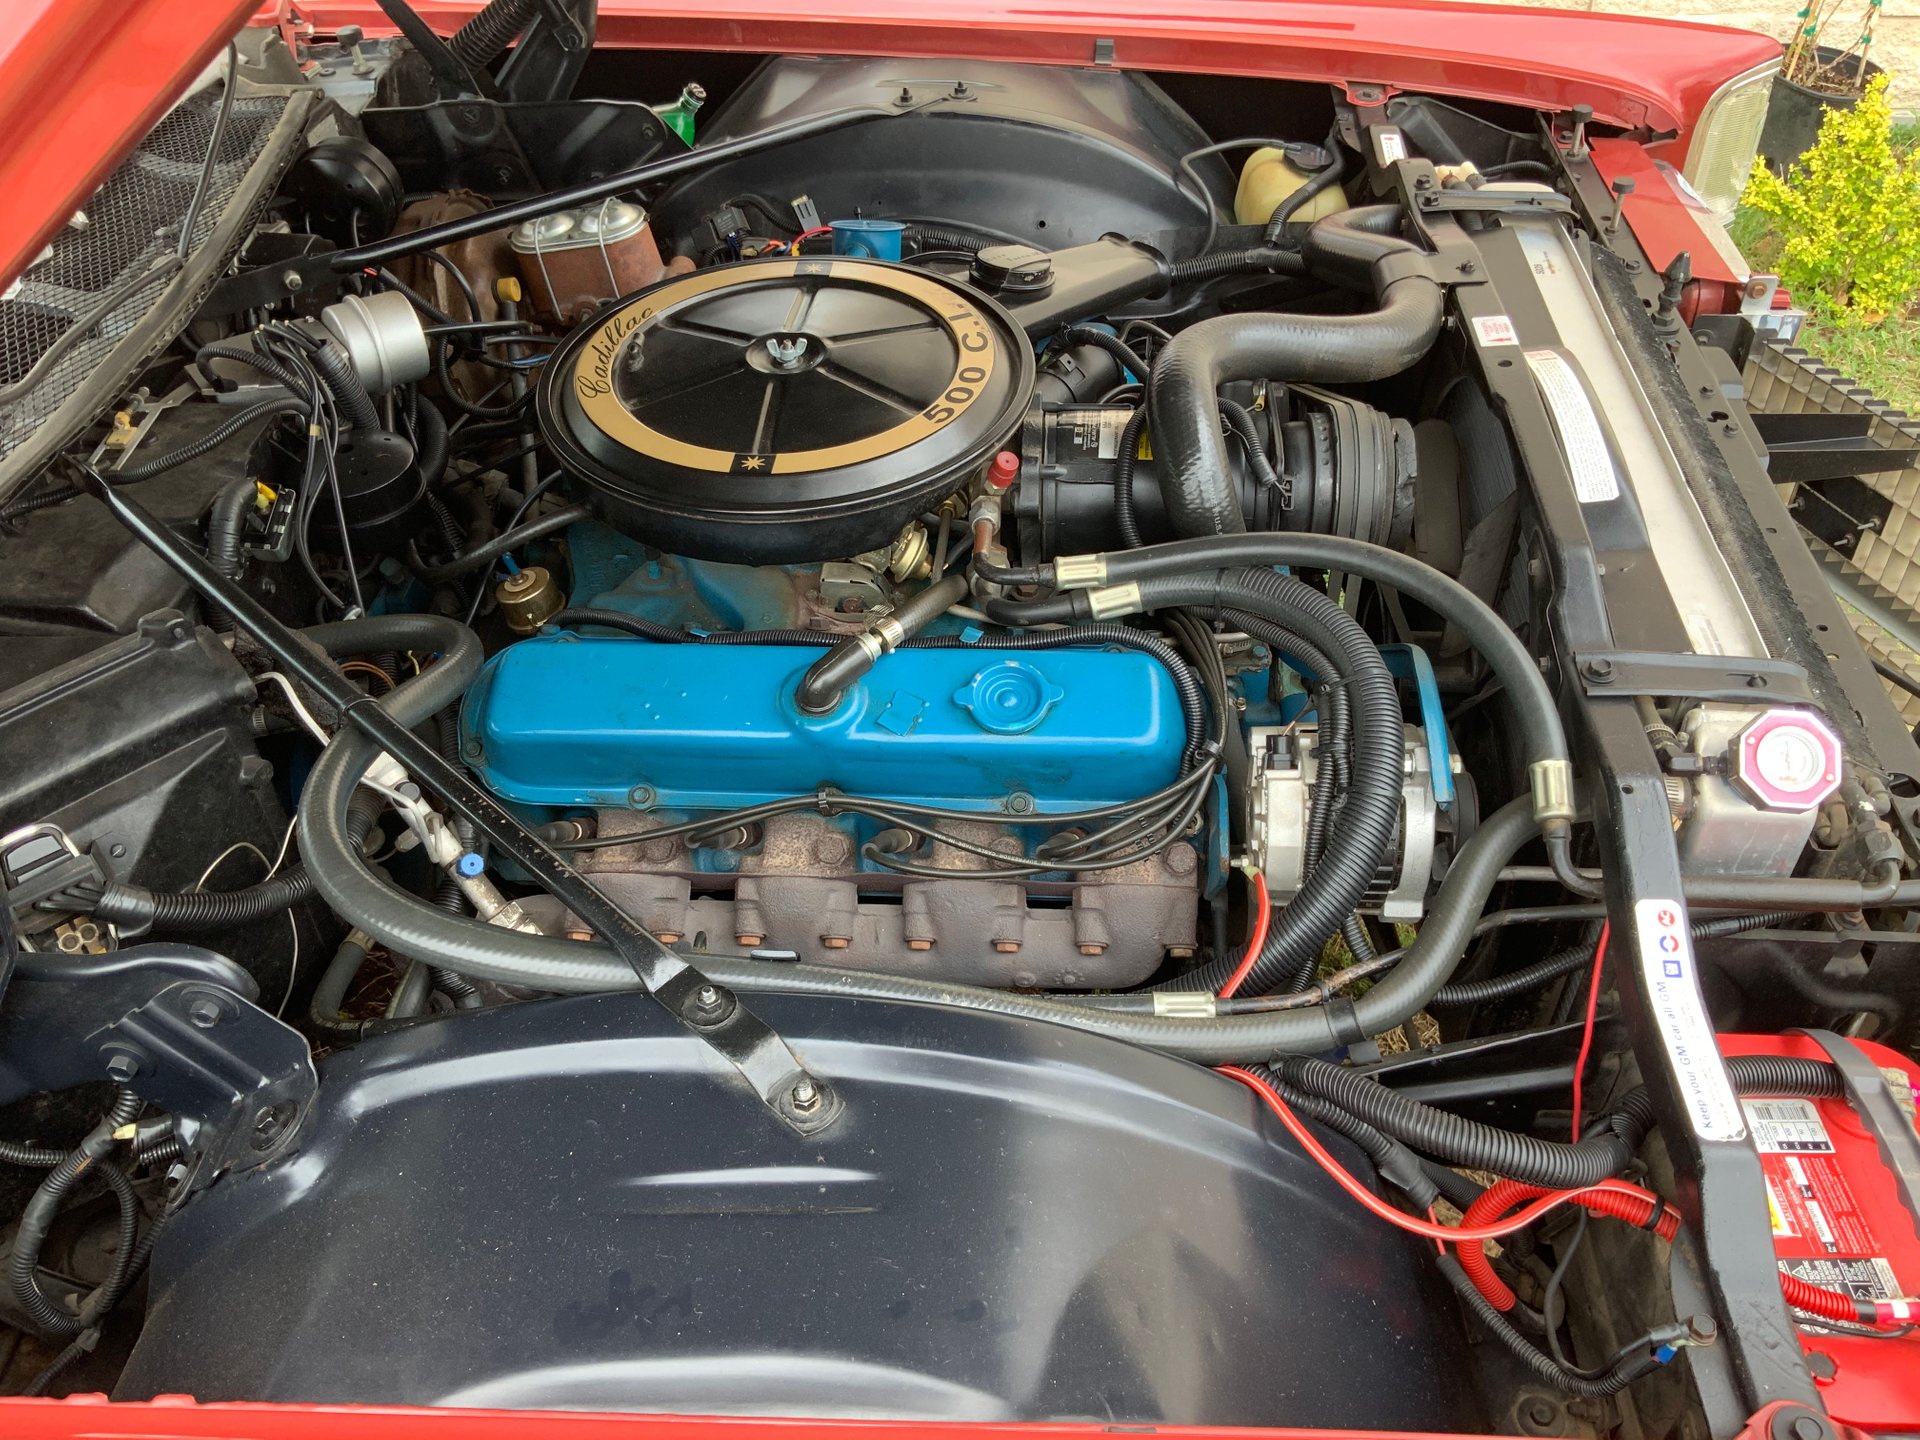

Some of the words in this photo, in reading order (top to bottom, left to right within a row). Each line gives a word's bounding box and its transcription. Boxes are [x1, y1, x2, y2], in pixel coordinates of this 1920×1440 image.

[577, 307, 653, 399] Cadillac
[922, 366, 986, 424] 500
[1659, 910, 1674, 927] AC
[1656, 981, 1670, 1002] GM
[1663, 1006, 1676, 1020] all
[1671, 1024, 1683, 1041] car
[1675, 1045, 1691, 1066] GM
[1686, 1071, 1703, 1095] your
[1697, 1099, 1713, 1129] Keep
